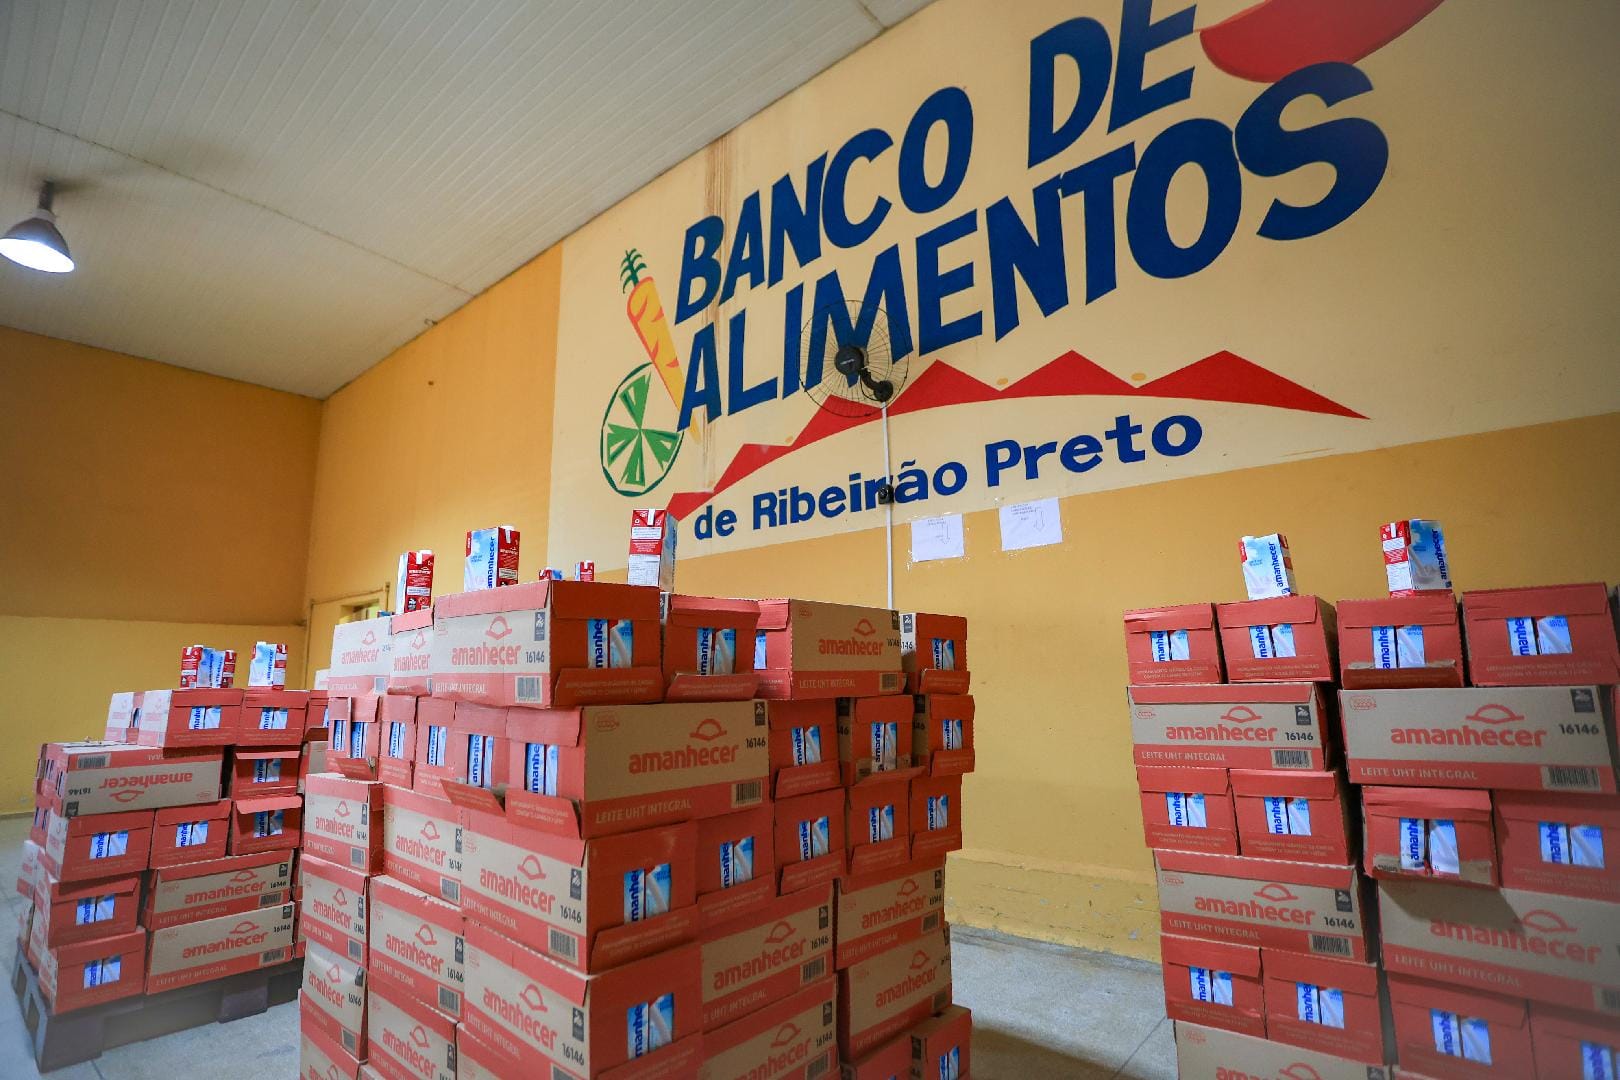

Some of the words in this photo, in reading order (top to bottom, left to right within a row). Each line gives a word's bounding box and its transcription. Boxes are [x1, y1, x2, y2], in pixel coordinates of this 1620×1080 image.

[675, 86, 974, 325] BANCO
[1027, 0, 1197, 169] DE
[677, 61, 1390, 432] ALIMENTOS
[694, 504, 737, 540] de
[752, 460, 968, 531] Ribeirão
[984, 415, 1203, 487] Preto
[1268, 541, 1284, 588] amanhecer
[1431, 528, 1448, 580] amanhecer
[452, 641, 522, 667] amanhecer
[525, 650, 545, 664] 16146
[595, 619, 603, 668] manhe
[818, 636, 884, 656] amanhecer
[1380, 626, 1390, 669] amanhe
[745, 737, 766, 749] 16146
[1166, 723, 1278, 742] amanhecer
[1285, 731, 1314, 742] 16146
[1390, 725, 1548, 748] amanhecer
[1559, 723, 1600, 735] 16146
[628, 744, 739, 775] amanhecer
[1141, 751, 1163, 760] LEITE
[1164, 752, 1183, 761] UHT
[1184, 752, 1226, 762] INTEGRAL
[99, 772, 193, 790] amanhecer
[1360, 767, 1389, 777] LEITE
[1391, 768, 1416, 778] UHT
[1418, 768, 1478, 780] INTEGRAL
[595, 811, 623, 824] LEITE
[625, 806, 645, 818] UHT
[645, 799, 692, 815] INTEGRAL
[315, 816, 354, 840] amanhecer
[395, 834, 447, 867] amanhecer
[184, 880, 266, 905] amanhecer
[480, 867, 556, 915] amanhecer
[313, 899, 352, 929] amanhecer
[560, 905, 582, 924] 16146
[861, 895, 927, 930] amanhecer
[1194, 894, 1316, 926] amanhecer
[1323, 916, 1355, 929] 16146
[810, 936, 829, 950] 16146
[1168, 919, 1192, 931] LEITE
[1193, 922, 1213, 935] UHT
[1214, 924, 1261, 941] INTEGRAL
[1430, 918, 1601, 963] amanhecer
[182, 931, 269, 959] amanhecer
[386, 932, 445, 975] amanhecer
[447, 967, 464, 983] 16146
[713, 937, 807, 991] amanhecer
[1394, 954, 1425, 969] LEITE
[1428, 960, 1455, 973] UHT
[1457, 964, 1522, 987] INTEGRAL
[308, 970, 344, 1009] amanhecer
[875, 964, 938, 1010] amanhecer
[482, 986, 558, 1052] amanhecer
[816, 1030, 832, 1047] 16146
[383, 1027, 437, 1080] amanhecer
[562, 1043, 584, 1066] 16146
